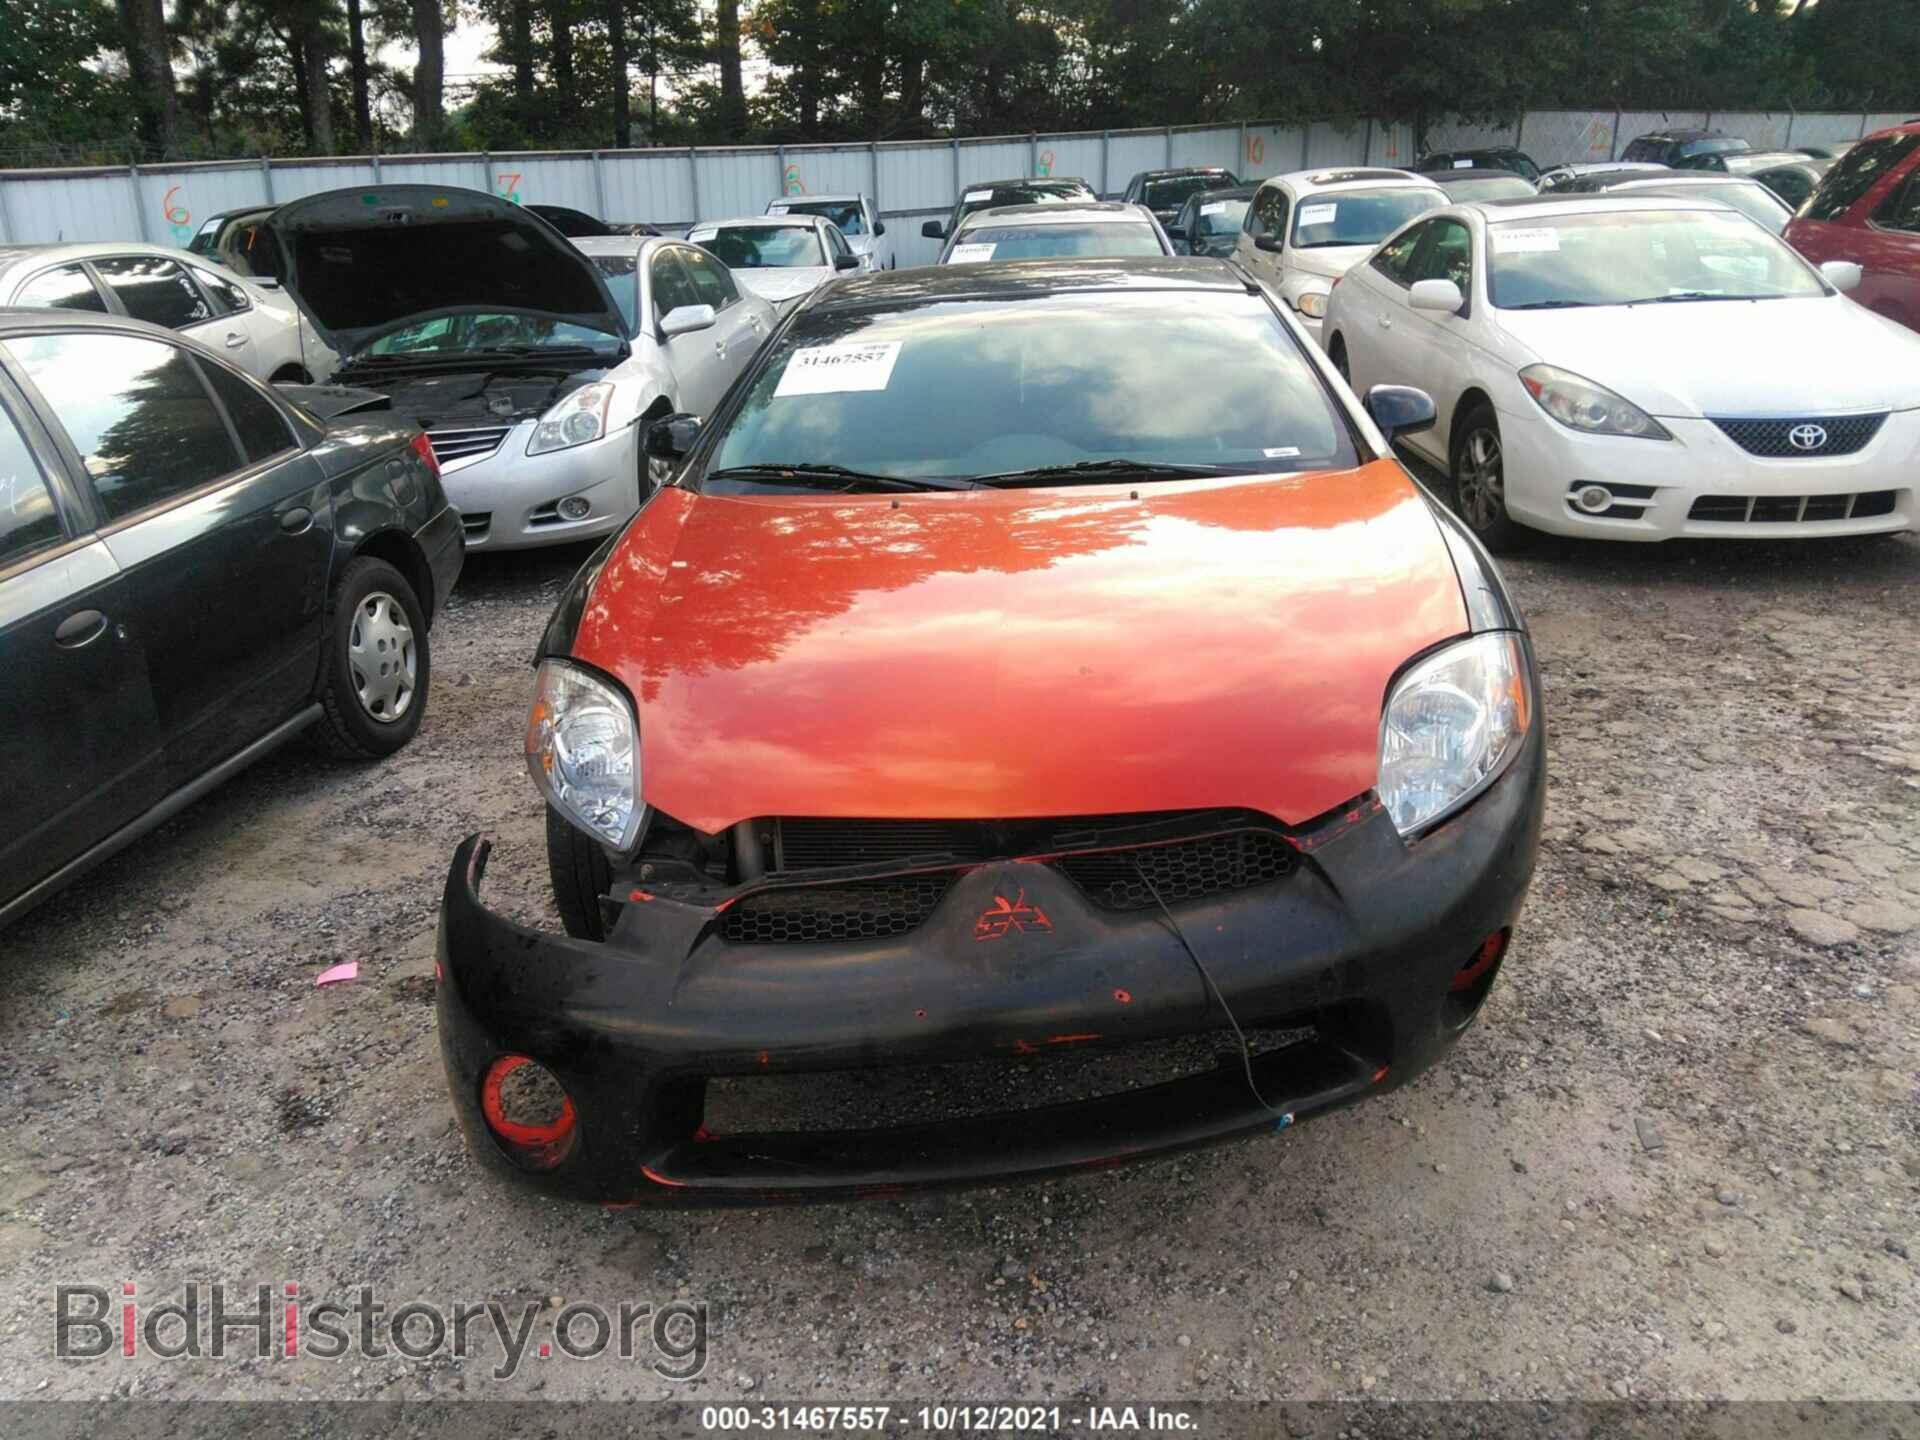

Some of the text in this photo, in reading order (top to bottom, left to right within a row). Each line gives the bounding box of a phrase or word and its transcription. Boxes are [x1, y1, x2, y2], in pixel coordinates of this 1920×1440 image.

[497, 173, 521, 200] 7
[163, 185, 191, 225] 6
[798, 351, 887, 367] 31467557
